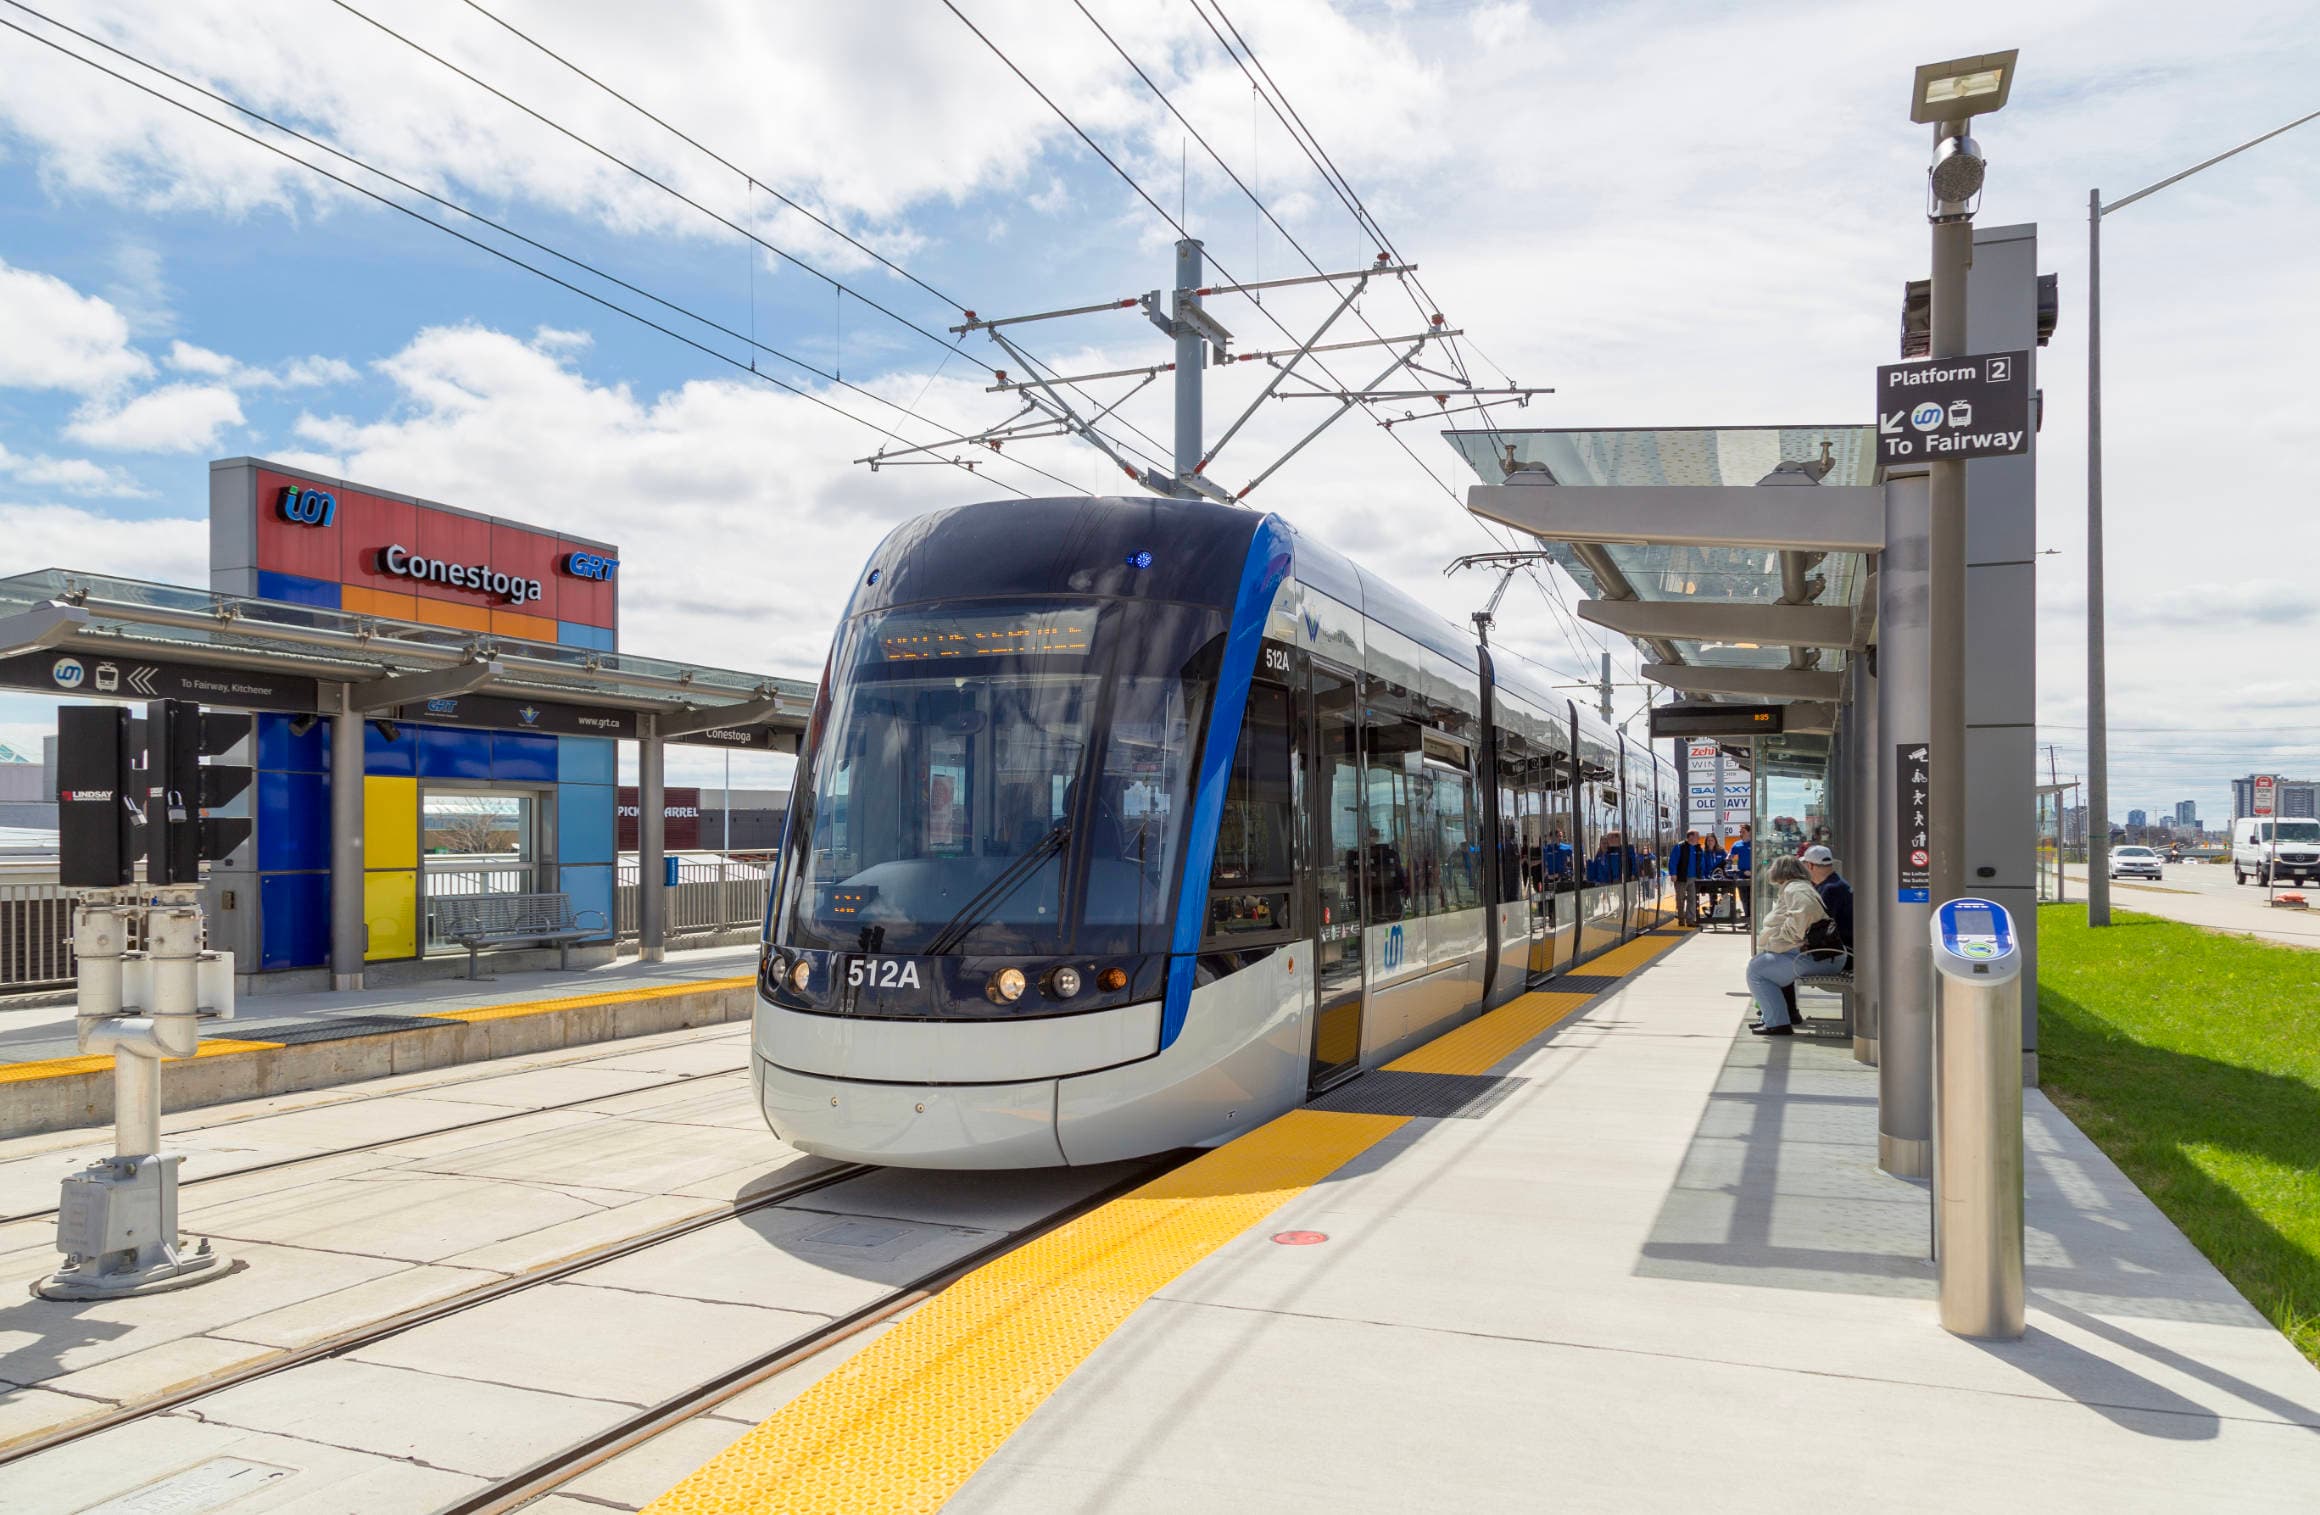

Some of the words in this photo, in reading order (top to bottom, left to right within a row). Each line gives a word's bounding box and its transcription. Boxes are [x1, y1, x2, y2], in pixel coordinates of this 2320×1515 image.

[1889, 366, 1976, 387] Platform
[1991, 361, 2006, 379] 2
[1885, 438, 1913, 456] To
[1925, 430, 2024, 453] Fairway
[387, 544, 542, 605] Conestoga
[569, 551, 620, 582] GRT
[1266, 648, 1290, 672] 512A
[181, 678, 192, 688] To
[194, 680, 230, 693] Fairway,
[231, 683, 272, 695] Kitchener
[578, 717, 620, 729] www.grt.ca
[706, 729, 751, 744] Conestoga
[72, 790, 113, 799] LINDSAY
[1723, 798, 1748, 808] AVY
[664, 806, 699, 818] ARREL
[847, 959, 921, 989] 512A
